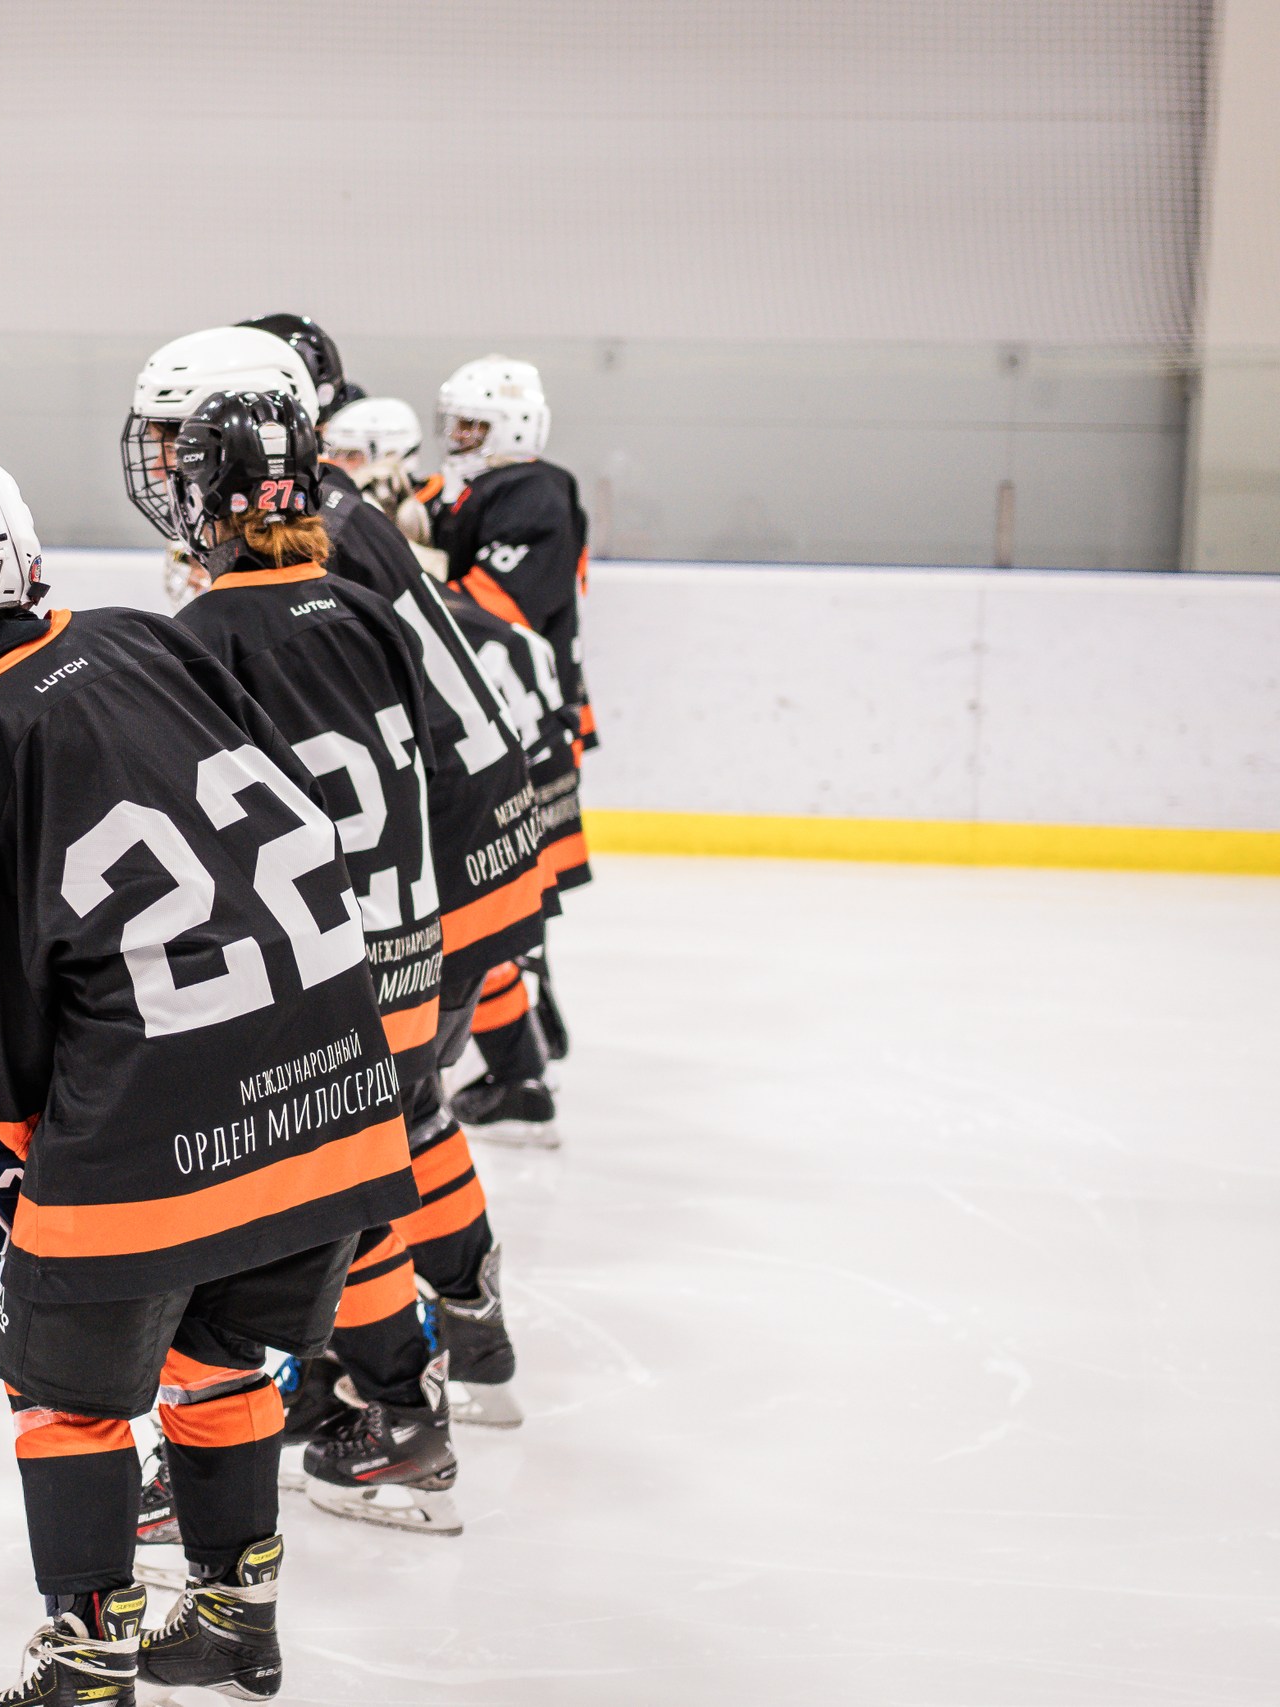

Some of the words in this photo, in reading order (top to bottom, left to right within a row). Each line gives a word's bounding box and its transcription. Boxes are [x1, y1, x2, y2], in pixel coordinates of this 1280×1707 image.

[183, 453, 205, 463] CCM
[258, 479, 295, 511] 27
[290, 598, 337, 617] LUTCH
[33, 657, 89, 694] LUTCH
[465, 834, 518, 887] ОРДЕН
[60, 743, 367, 1039] 22
[239, 1027, 363, 1106] МЕЖДУНАРОДНЫЙ
[173, 1115, 257, 1175] ОРДЕН
